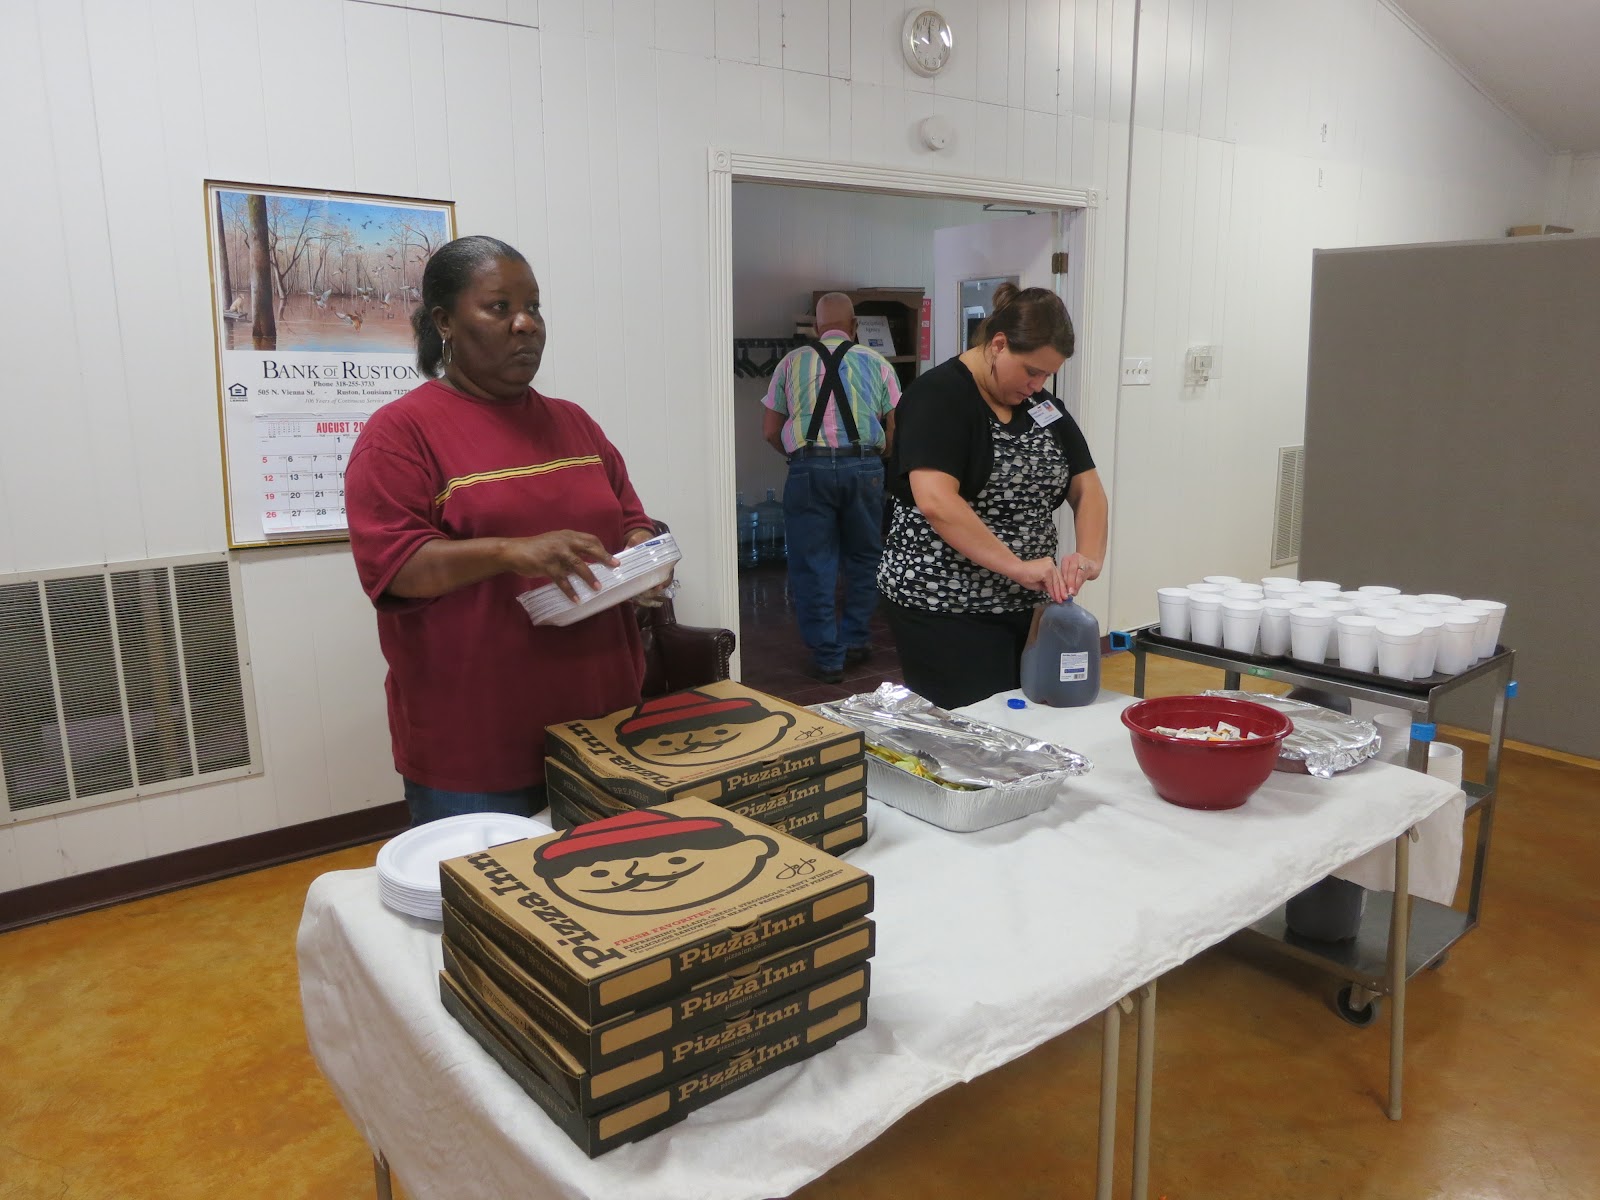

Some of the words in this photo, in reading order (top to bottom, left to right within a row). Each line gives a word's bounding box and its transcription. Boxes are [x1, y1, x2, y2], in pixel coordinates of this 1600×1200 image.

[262, 360, 320, 379] BANK
[323, 366, 338, 378] OF
[341, 360, 420, 380] RUSTON
[336, 389, 361, 397] Ruston,
[316, 422, 350, 433] AUGUST
[353, 421, 365, 433] 20
[264, 474, 274, 482] 12
[289, 473, 299, 481] 13
[727, 766, 782, 791] Pizza
[783, 755, 815, 774] Inn
[734, 794, 788, 817] Pizza
[788, 783, 820, 802] Inn
[788, 811, 819, 831] Inn
[467, 852, 531, 896] Inn
[623, 929, 676, 950] REFRESHING
[708, 906, 737, 920] CHEESY
[809, 869, 833, 880] WINGS
[629, 934, 674, 953] DELICIOUS
[728, 903, 758, 917] HEARTY
[787, 883, 810, 895] SWEET
[517, 891, 627, 969] Pizza
[613, 930, 651, 946] FRESH
[679, 932, 760, 972] Pizza
[761, 911, 806, 939] Inn
[724, 941, 767, 963] pizzainn.com
[681, 979, 760, 1020] Pizza
[762, 959, 806, 987] Inn
[725, 988, 768, 1011] pizzainn.com
[672, 1021, 753, 1063] Pizza
[755, 1002, 801, 1030] Inn
[678, 1057, 755, 1102] Pizza
[756, 1035, 801, 1065] Inn
